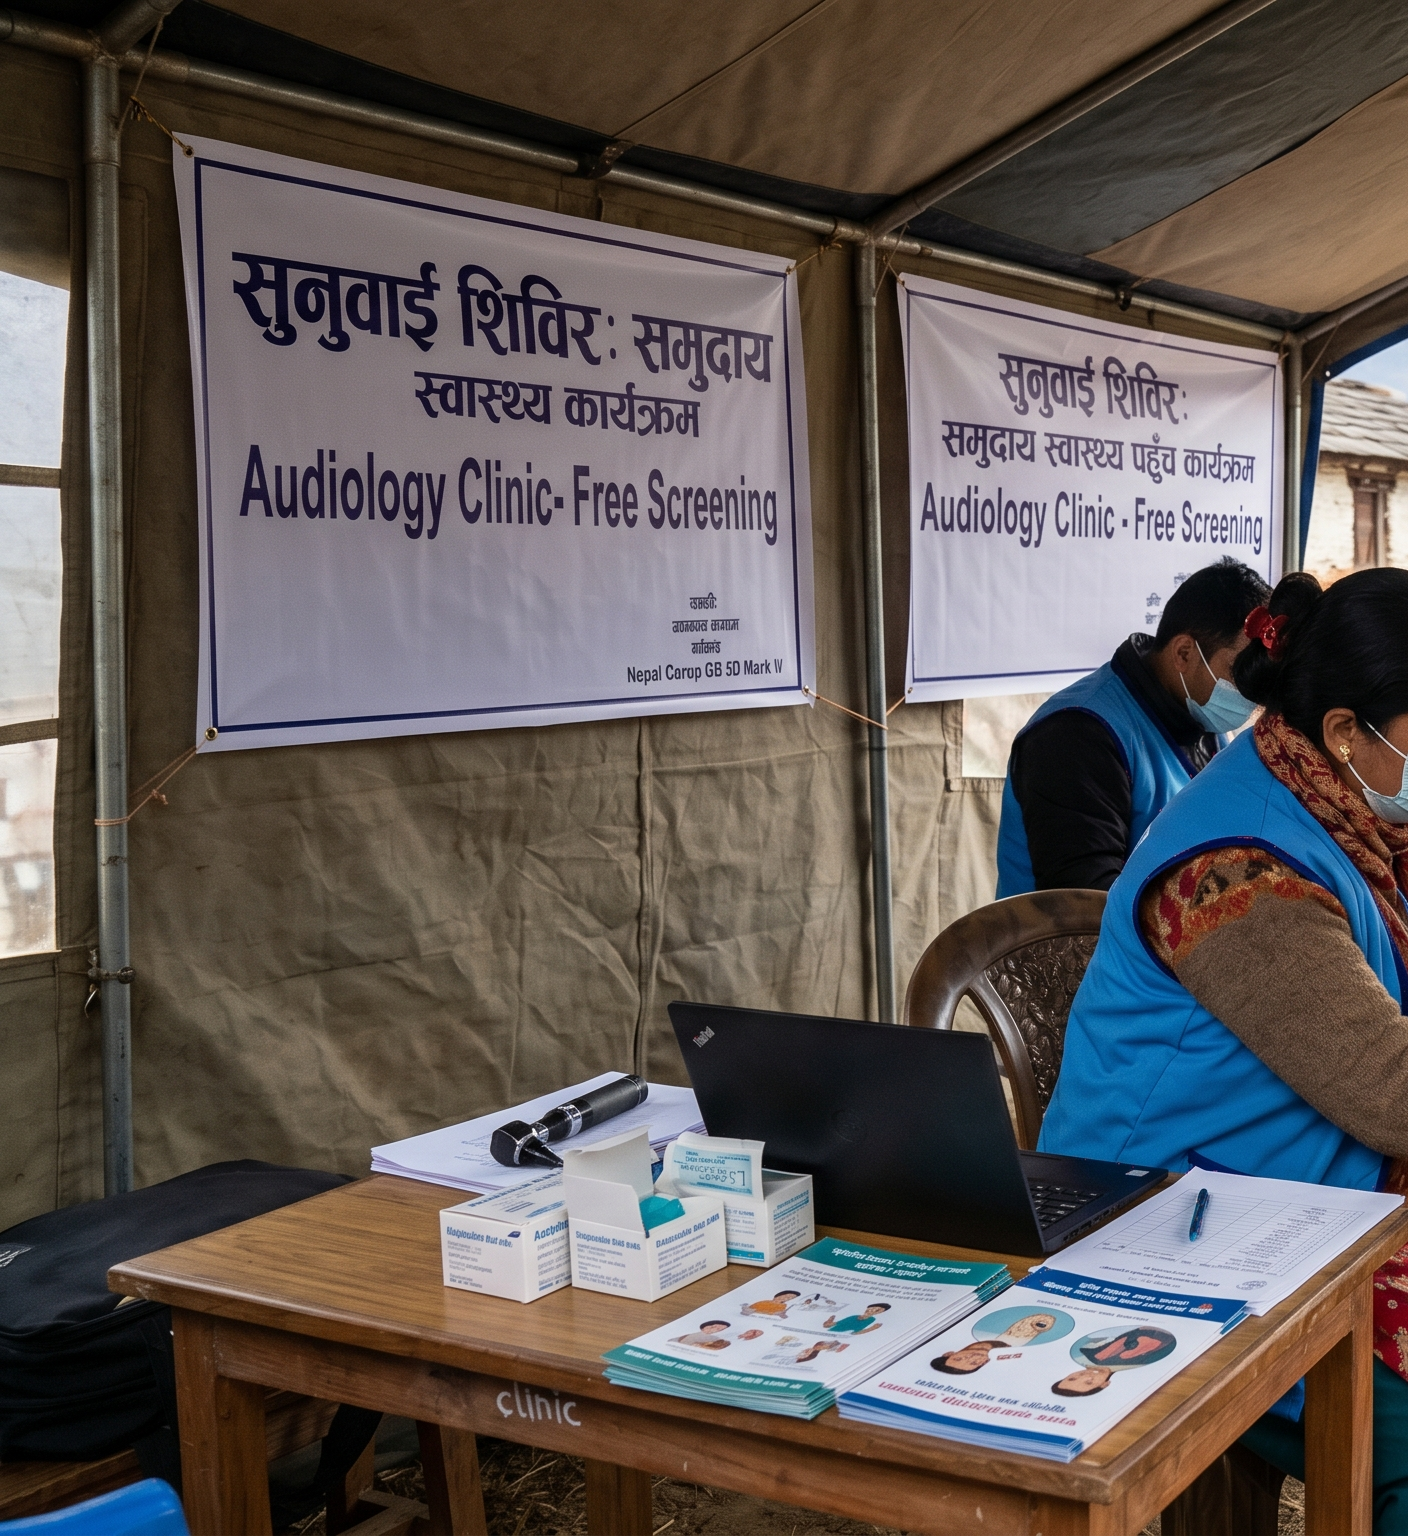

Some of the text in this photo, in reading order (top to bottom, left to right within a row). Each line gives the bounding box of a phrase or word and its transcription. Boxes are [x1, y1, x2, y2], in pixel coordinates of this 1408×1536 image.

[231, 251, 441, 353] सुनुवाई
[632, 313, 774, 393] समुदाय
[414, 370, 701, 438] स्वास्थ्य कार्यक्रम
[997, 352, 1096, 419] सुनुवाई
[942, 419, 1256, 485] समुदाय स्वास्थ्य पहुँच कार्यक्रम
[238, 444, 447, 541] Audiology
[573, 464, 639, 530] Free
[647, 468, 778, 547] Screening
[919, 481, 1048, 549] Audiology
[1054, 490, 1116, 540] Clinic
[1134, 496, 1176, 543] Free
[1181, 499, 1263, 556] Screening
[626, 664, 663, 687] Nepal
[704, 661, 723, 678] GB
[725, 660, 741, 677] 5D
[743, 658, 772, 676] Mark
[496, 1382, 582, 1427] clinic
